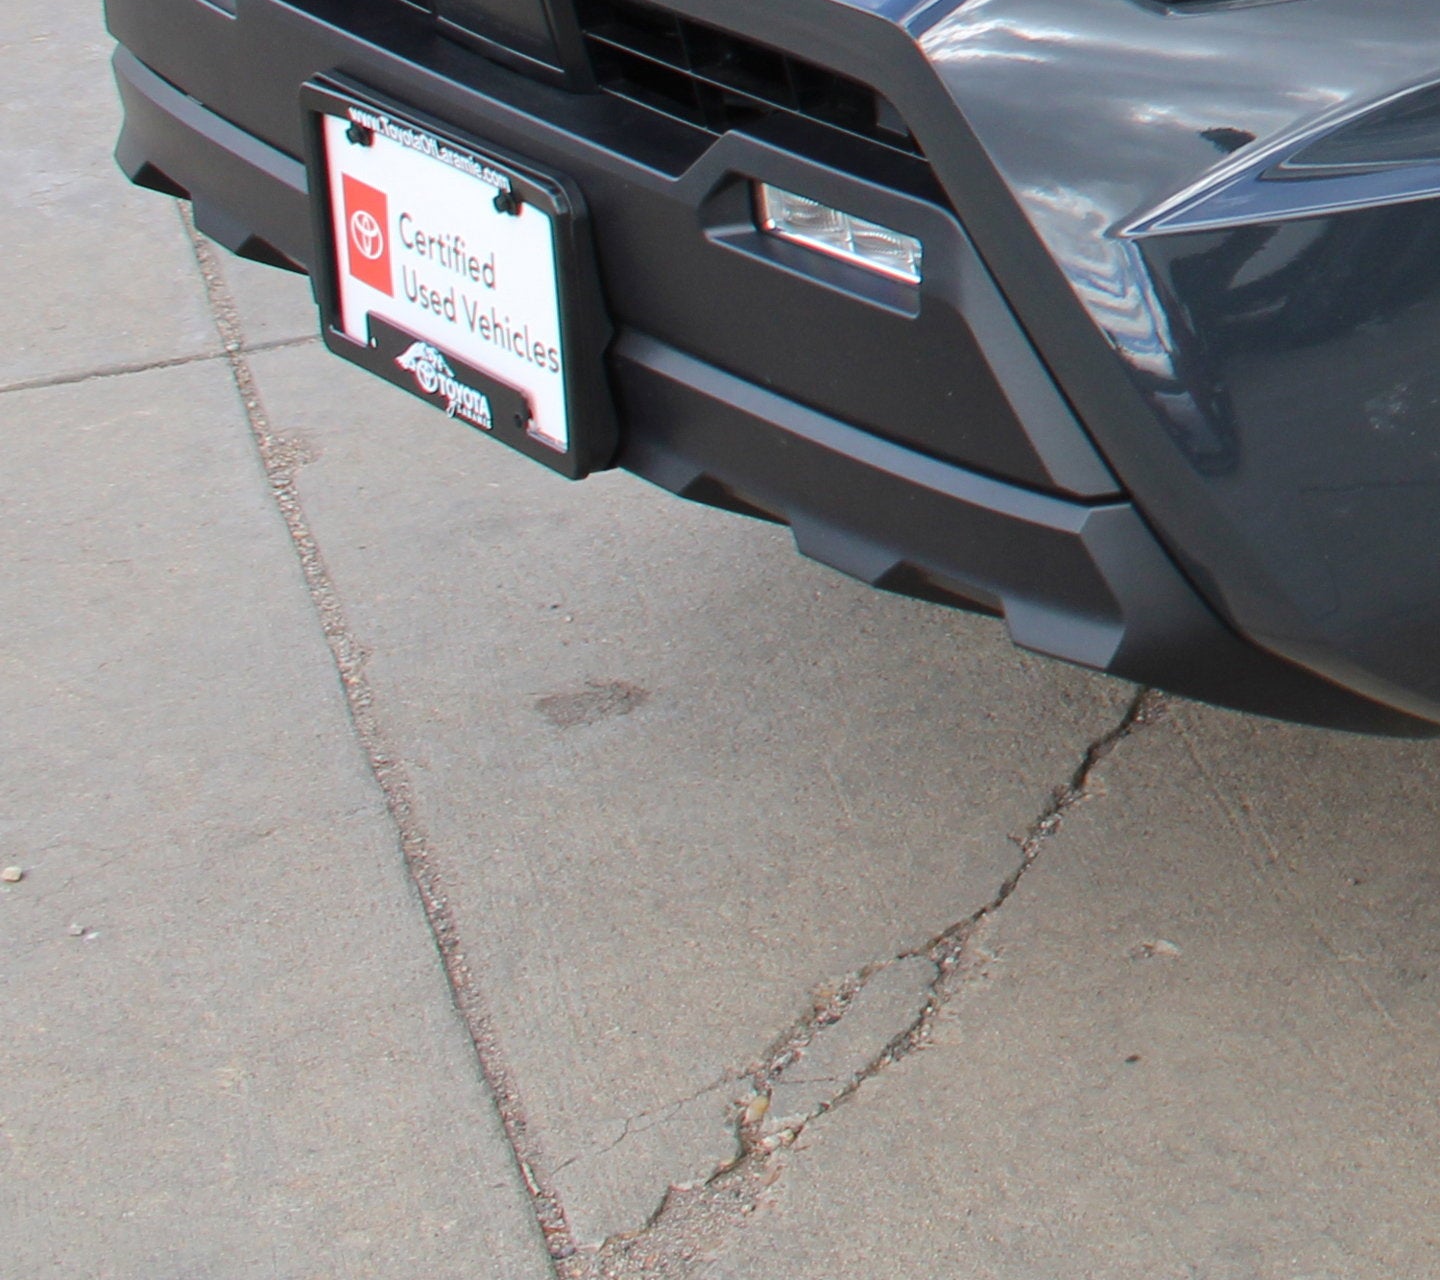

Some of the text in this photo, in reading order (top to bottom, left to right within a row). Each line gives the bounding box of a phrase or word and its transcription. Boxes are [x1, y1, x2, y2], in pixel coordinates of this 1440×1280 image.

[399, 212, 497, 290] Certified
[402, 264, 560, 373] Used Vehicles
